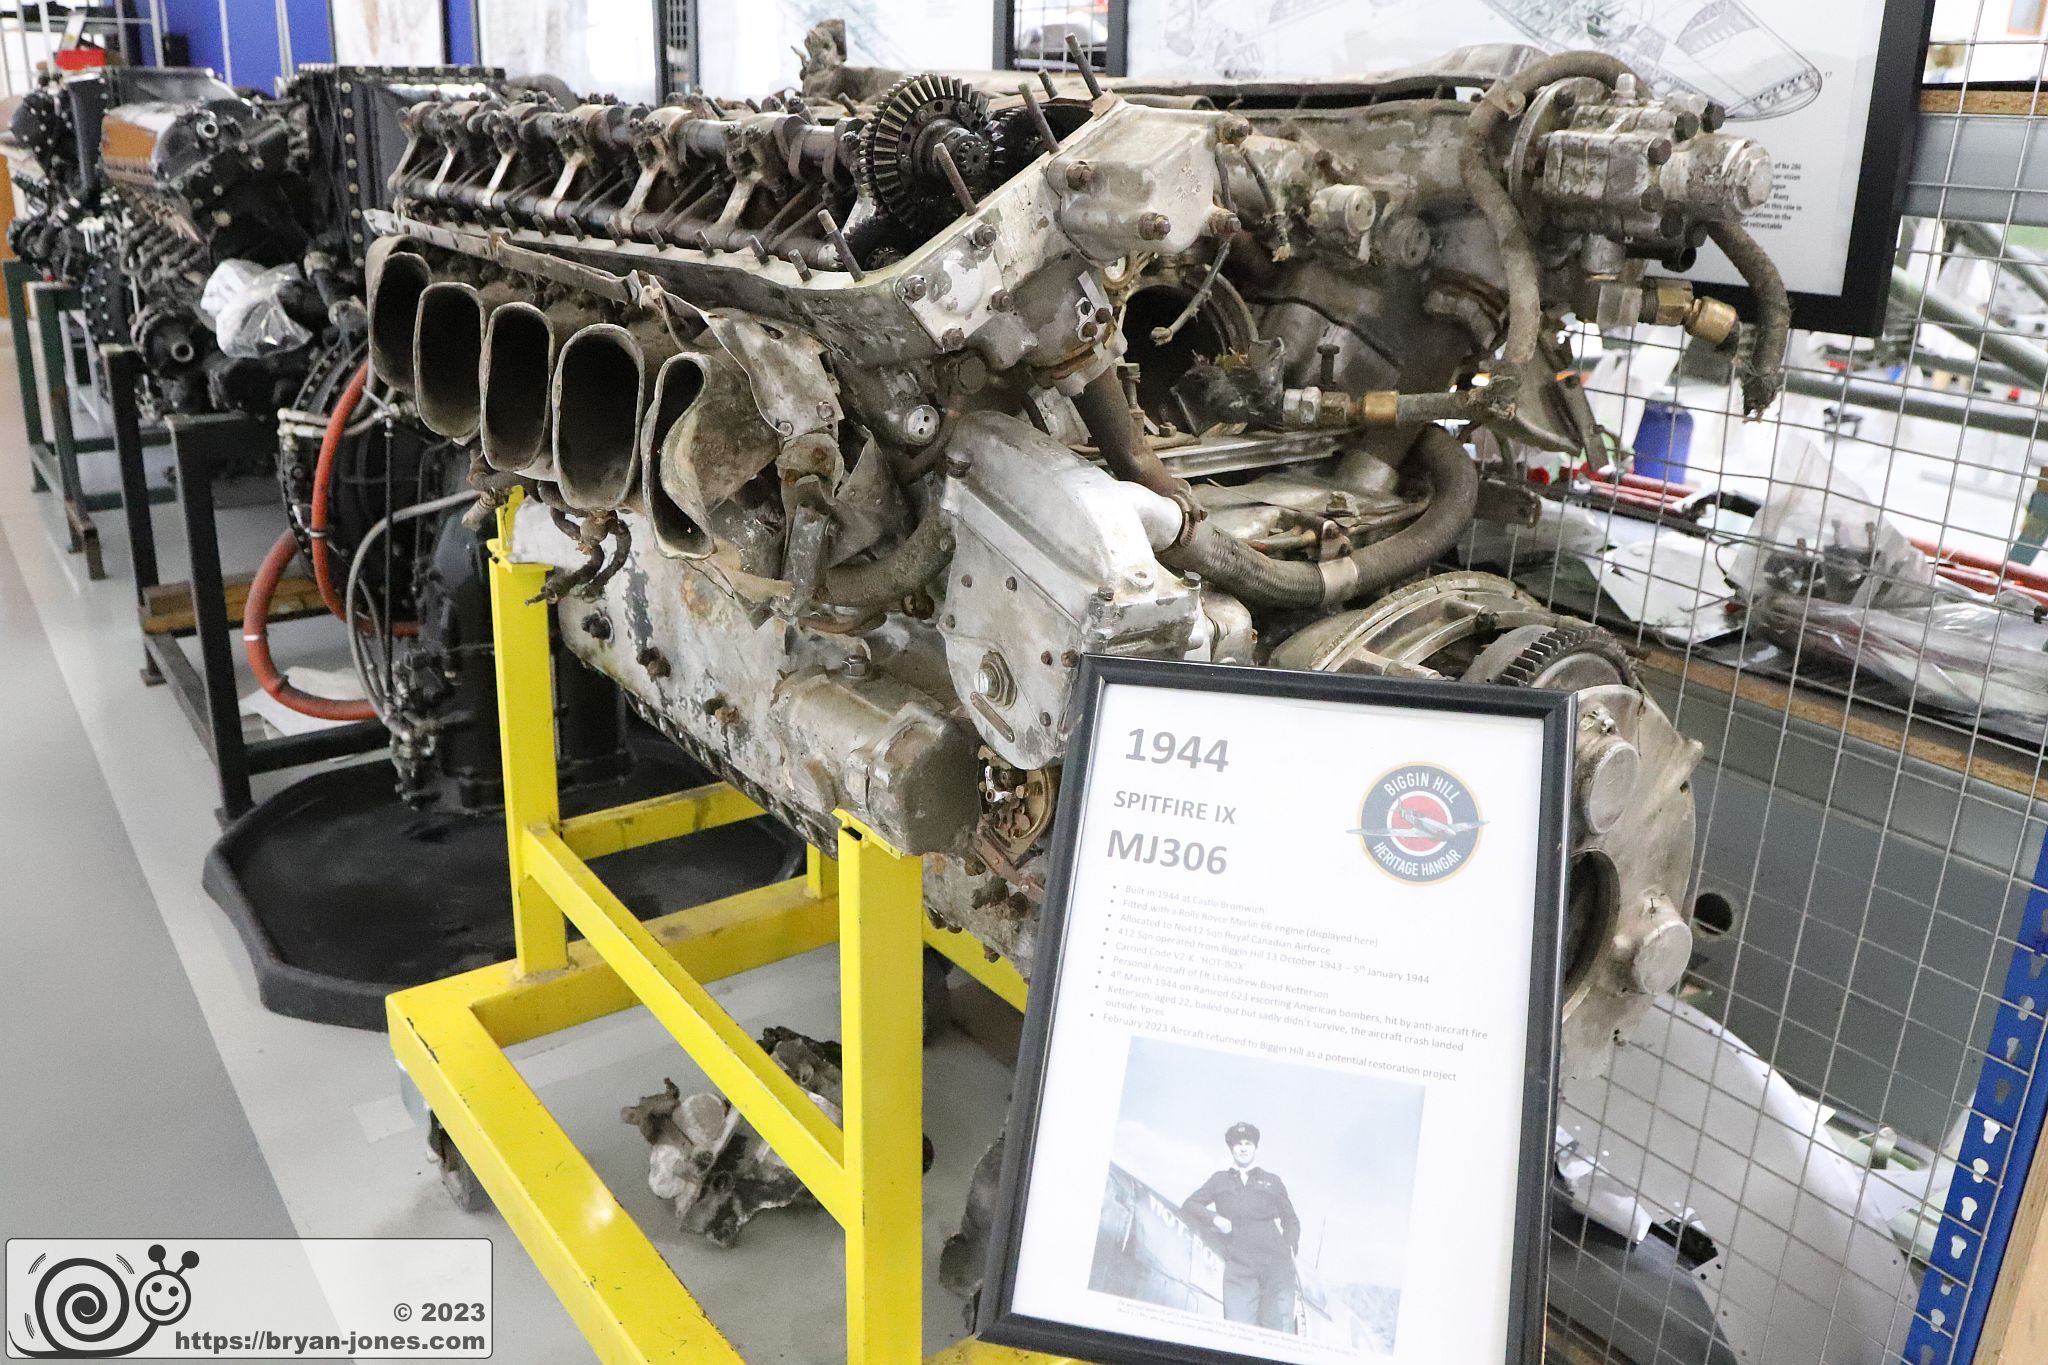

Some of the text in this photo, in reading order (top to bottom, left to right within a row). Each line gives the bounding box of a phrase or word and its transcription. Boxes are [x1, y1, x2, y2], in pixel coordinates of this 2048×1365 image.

[1125, 728, 1229, 772] 1944
[1113, 790, 1237, 825] SPITFIRE IX
[1384, 772, 1461, 805] BIGGIN HILL
[1106, 830, 1228, 875] MJ306
[1373, 841, 1462, 877] HERITAGE HANGAR
[1126, 884, 1265, 914] Built in 1944 at Castle Bromwich
[1120, 913, 1160, 928] Allocated
[1163, 921, 1172, 930] to
[1206, 928, 1223, 940] Sqn
[1225, 931, 1250, 944] Royal
[1252, 935, 1292, 949] Canadian
[1294, 941, 1331, 956] Airforce
[1123, 899, 1148, 911] Fitted
[1151, 905, 1169, 914] with
[1179, 908, 1199, 919] Rolls
[1202, 912, 1228, 924] Royce
[1230, 916, 1258, 929] Merlin
[1261, 922, 1272, 931] 66
[1274, 925, 1305, 936] engine
[1306, 928, 1352, 943] (displayed
[1354, 936, 1379, 948] here)
[1116, 942, 1148, 955] Carried
[1150, 947, 1171, 959] Code
[1118, 928, 1135, 938] 412
[1138, 930, 1153, 942] Sqn
[1155, 935, 1195, 948] operated
[1198, 941, 1219, 952] from
[1221, 944, 1248, 957] Biggin
[1250, 949, 1264, 959] Hill
[1266, 952, 1278, 961] 13
[1280, 954, 1316, 968] October
[1320, 960, 1342, 971] 1943
[1353, 964, 1366, 975] 5th
[1368, 968, 1403, 982] January
[1406, 972, 1430, 984] 1944
[1113, 955, 1151, 969] Personal
[1152, 962, 1186, 976] Aircraft
[1188, 968, 1198, 977] of
[1222, 974, 1258, 988] Andrew
[1260, 980, 1283, 993] Boyd
[1286, 984, 1329, 999] Ketterson
[1105, 1000, 1165, 1017] outside Ypres
[1108, 984, 1465, 1052] Ketterson, aged 22, bailed out but sadly didn't survive, the aircraft crash landed
[1124, 972, 1152, 985] March
[1155, 978, 1177, 989] 1944
[1194, 984, 1229, 999] Ramrod
[1231, 990, 1248, 1001] 623
[1250, 996, 1292, 1011] escorting
[1294, 1002, 1337, 1016] American
[1340, 1008, 1382, 1025] bombers,
[1385, 1015, 1397, 1025] hit
[1400, 1017, 1411, 1029] by
[1414, 1020, 1469, 1037] anti-aircraft
[1472, 1028, 1488, 1040] fire
[1103, 1012, 1143, 1029] February
[1144, 1020, 1168, 1033] 2023
[1170, 1025, 1204, 1039] Aircraft
[1206, 1032, 1246, 1047] returned
[1248, 1039, 1258, 1049] to
[1260, 1040, 1287, 1054] Biggin
[1290, 1046, 1305, 1057] Hill
[1306, 1050, 1316, 1058] as
[1325, 1053, 1367, 1068] potential
[1368, 1060, 1420, 1076] restoration
[1422, 1069, 1457, 1082] project
